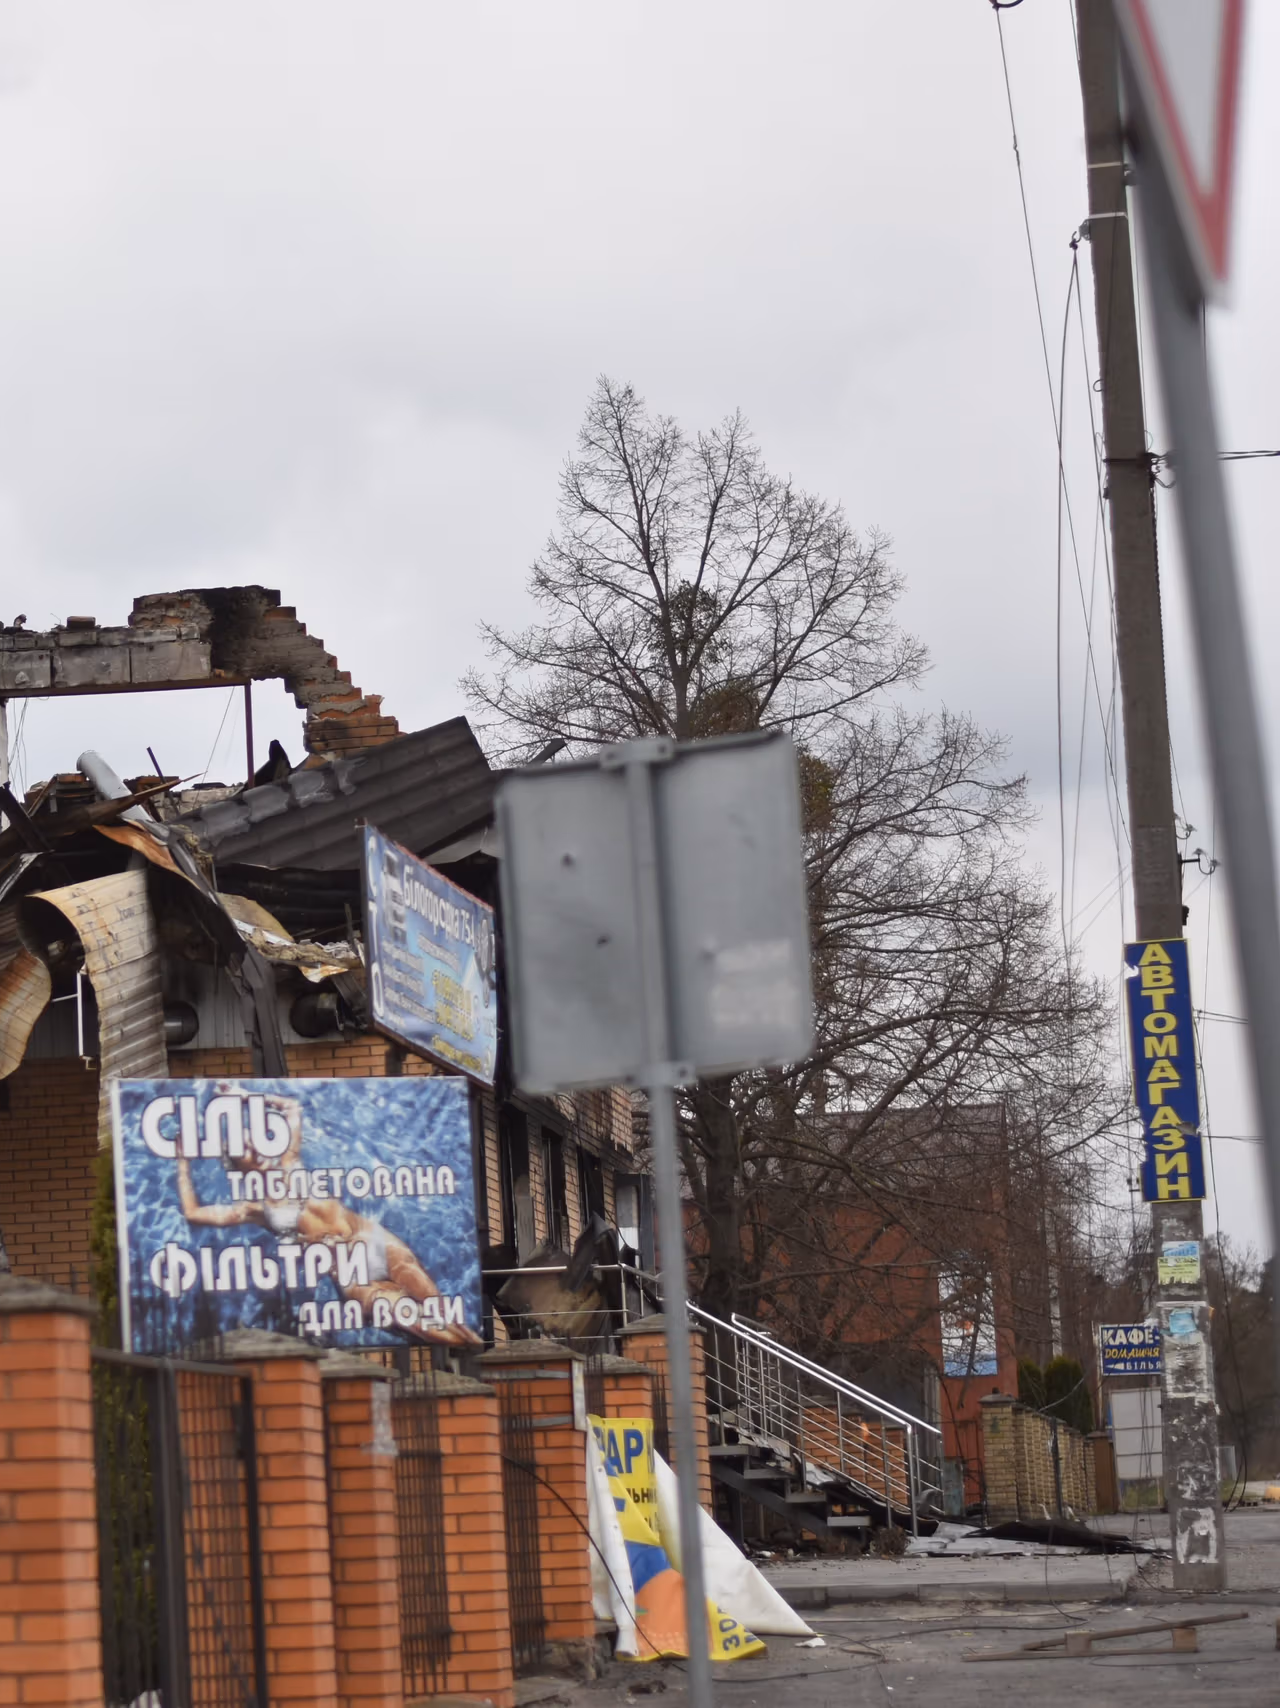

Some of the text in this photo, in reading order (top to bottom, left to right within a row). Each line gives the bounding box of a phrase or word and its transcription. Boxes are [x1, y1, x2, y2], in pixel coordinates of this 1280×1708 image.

[368, 835, 385, 1018] СТО
[1138, 943, 1192, 1199] АВТОМАГАЗИН
[141, 1095, 291, 1158] СІЛЬ
[226, 1164, 455, 1200] ТАБЛЕТОВАНА
[150, 1240, 369, 1298] ФІЛЬТРИ
[298, 1296, 464, 1337] ДЛЯ ВОДИ
